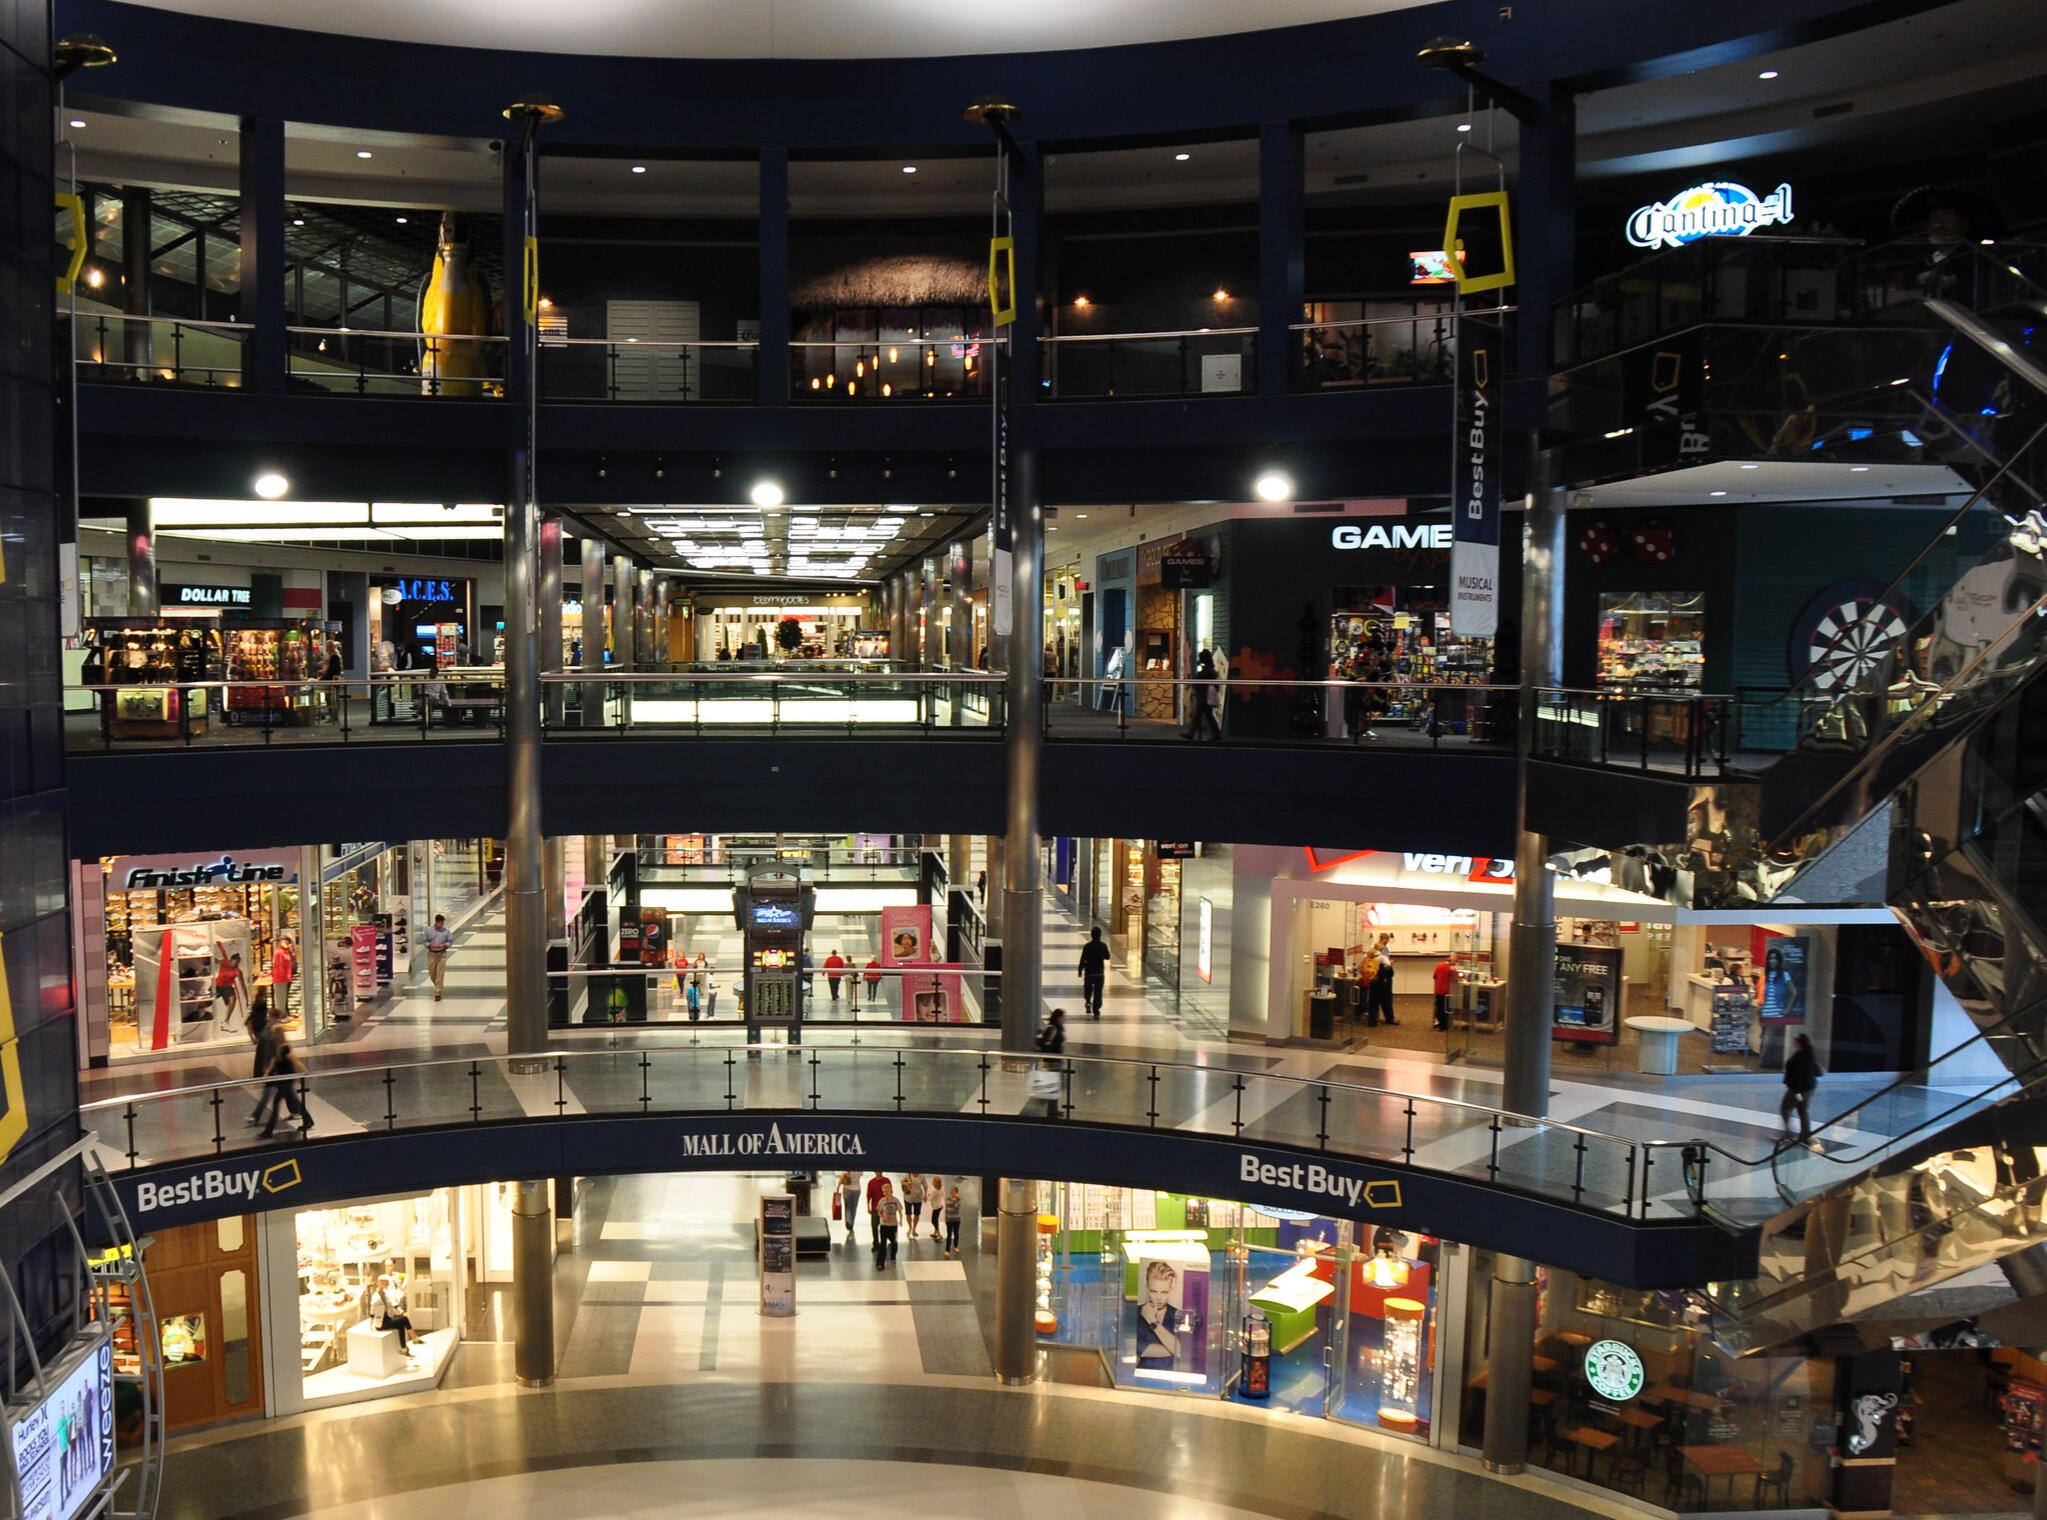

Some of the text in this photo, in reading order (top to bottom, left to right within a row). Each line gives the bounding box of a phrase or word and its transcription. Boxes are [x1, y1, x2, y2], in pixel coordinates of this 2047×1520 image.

[1167, 558, 1205, 566] GAMES
[398, 579, 455, 602] A.C.E.S.
[1458, 576, 1493, 591] MUSICAL
[181, 587, 251, 603] DOLLAR TREE
[1457, 592, 1493, 602] INSTRUMENTS
[127, 865, 213, 889] Finish
[1310, 902, 1330, 910] E280
[1560, 963, 1609, 975] ANY FREE
[682, 1121, 865, 1156] MALL OF AMERICA
